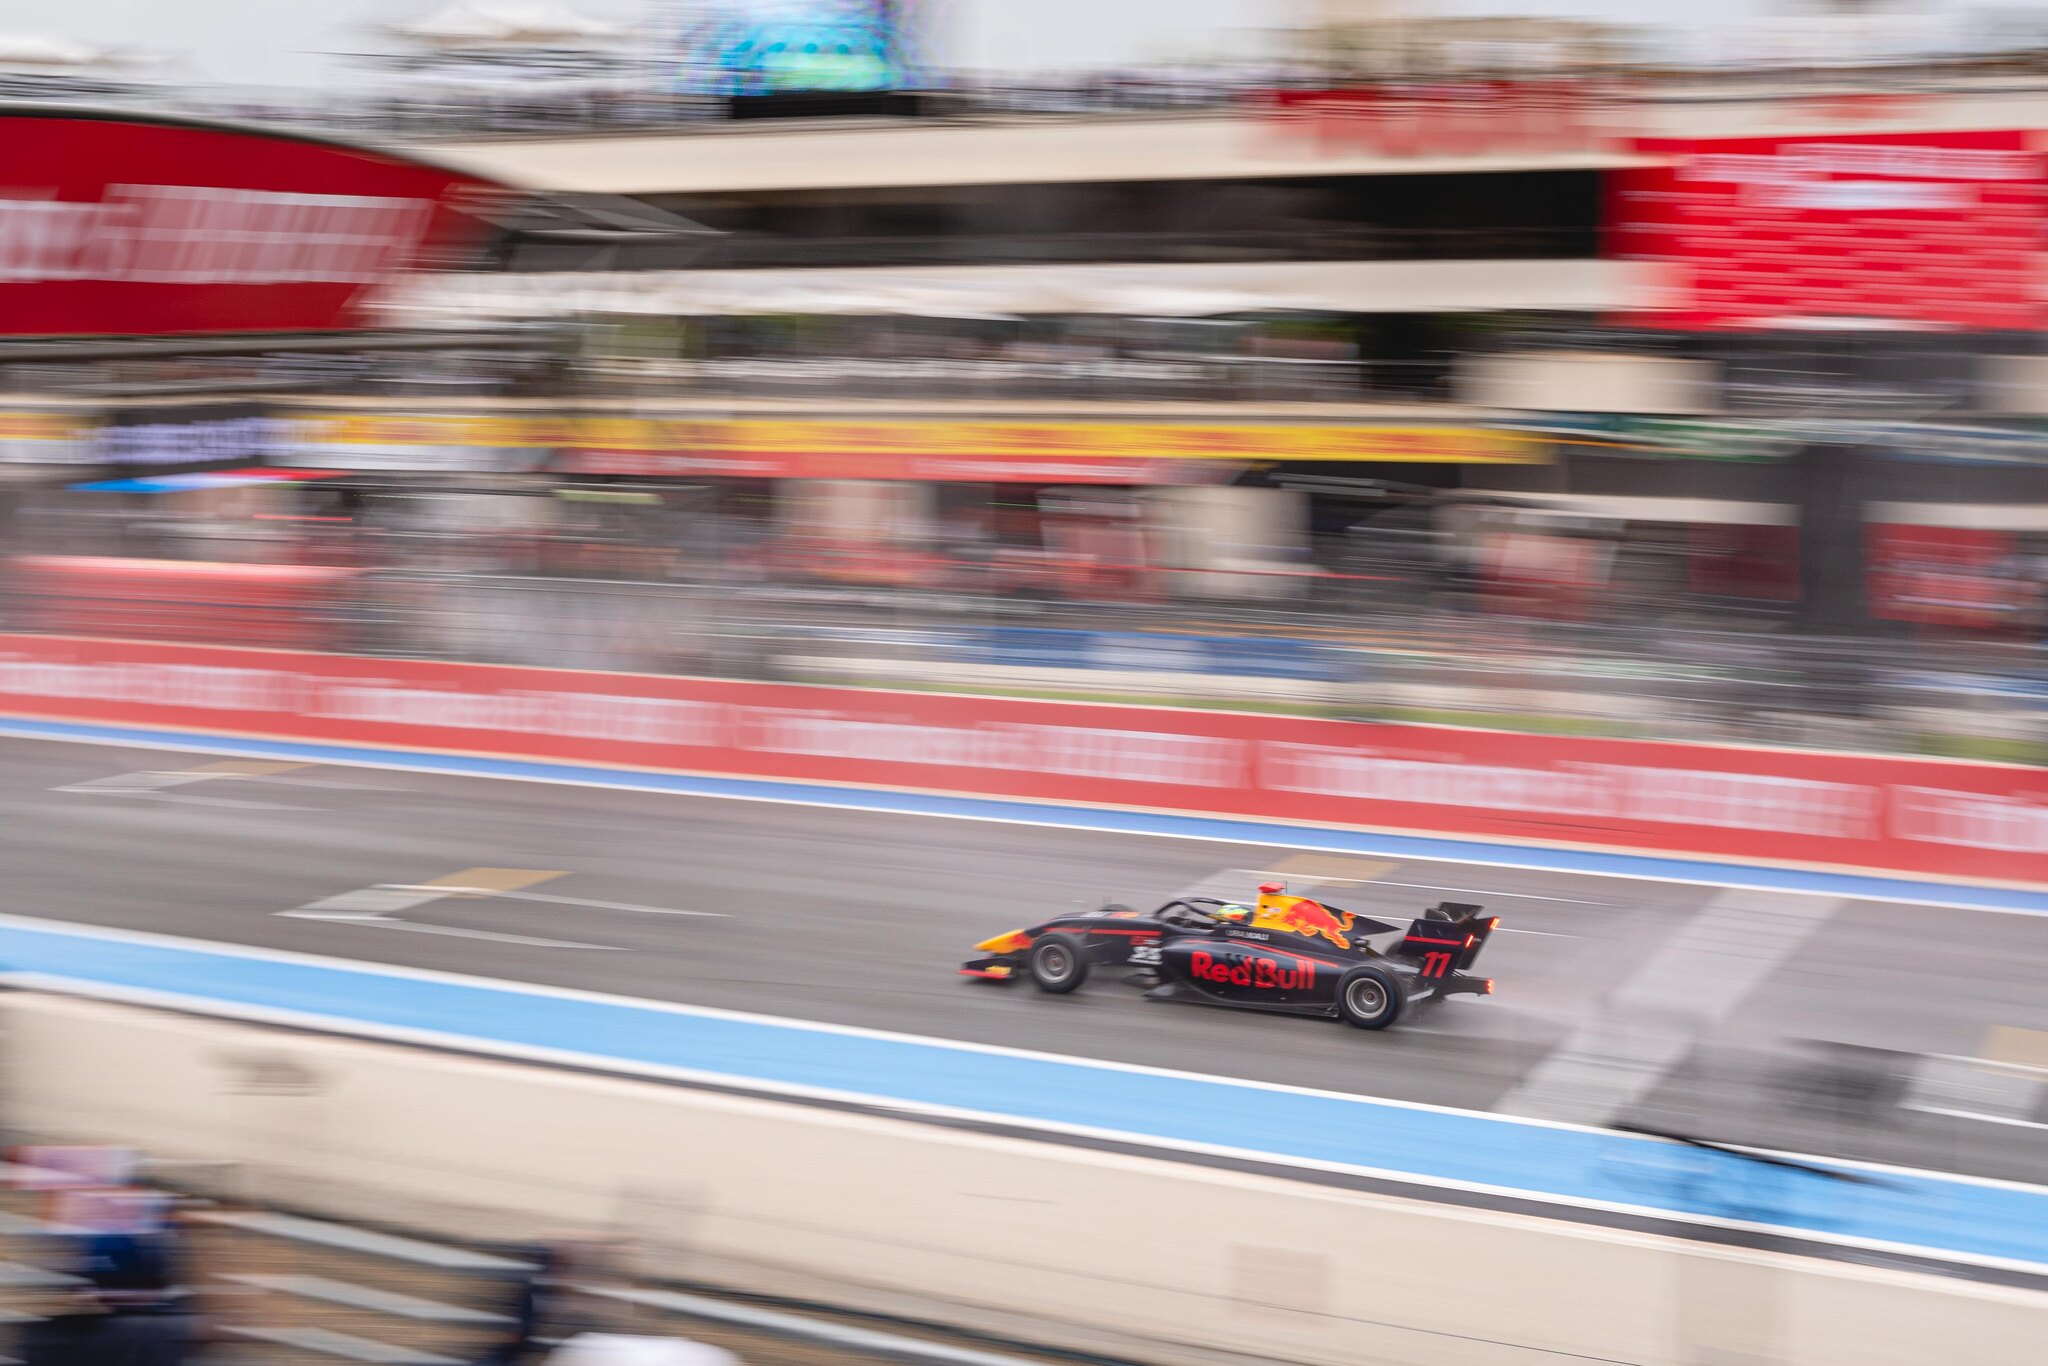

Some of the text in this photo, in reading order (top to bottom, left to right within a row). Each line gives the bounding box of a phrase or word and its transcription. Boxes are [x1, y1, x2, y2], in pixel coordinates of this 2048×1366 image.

[1191, 950, 1253, 986] Red
[1255, 958, 1316, 990] Bull
[1422, 951, 1452, 978] 11
